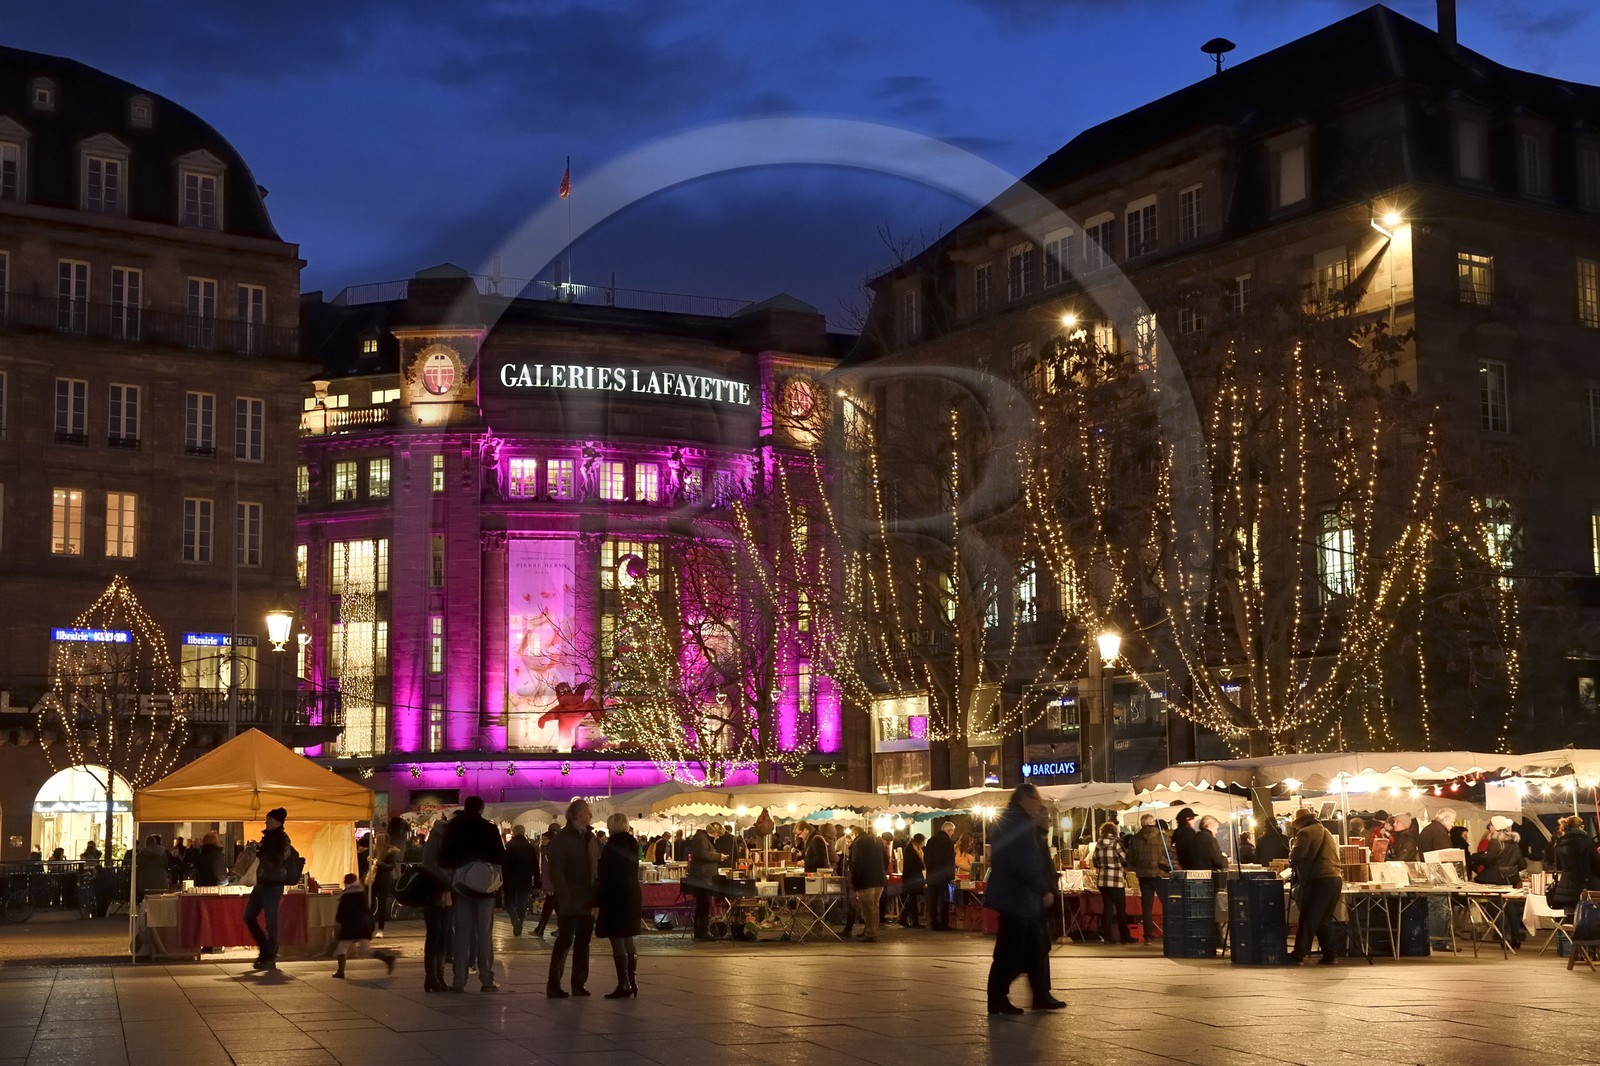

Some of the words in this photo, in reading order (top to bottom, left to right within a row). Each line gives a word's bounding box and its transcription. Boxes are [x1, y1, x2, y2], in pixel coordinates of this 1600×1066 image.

[500, 363, 626, 392] GALERIES
[631, 369, 751, 406] LAFAYETTE
[187, 635, 218, 645] librairie
[223, 636, 253, 646] KLBER
[1032, 762, 1075, 775] BARCLAYS
